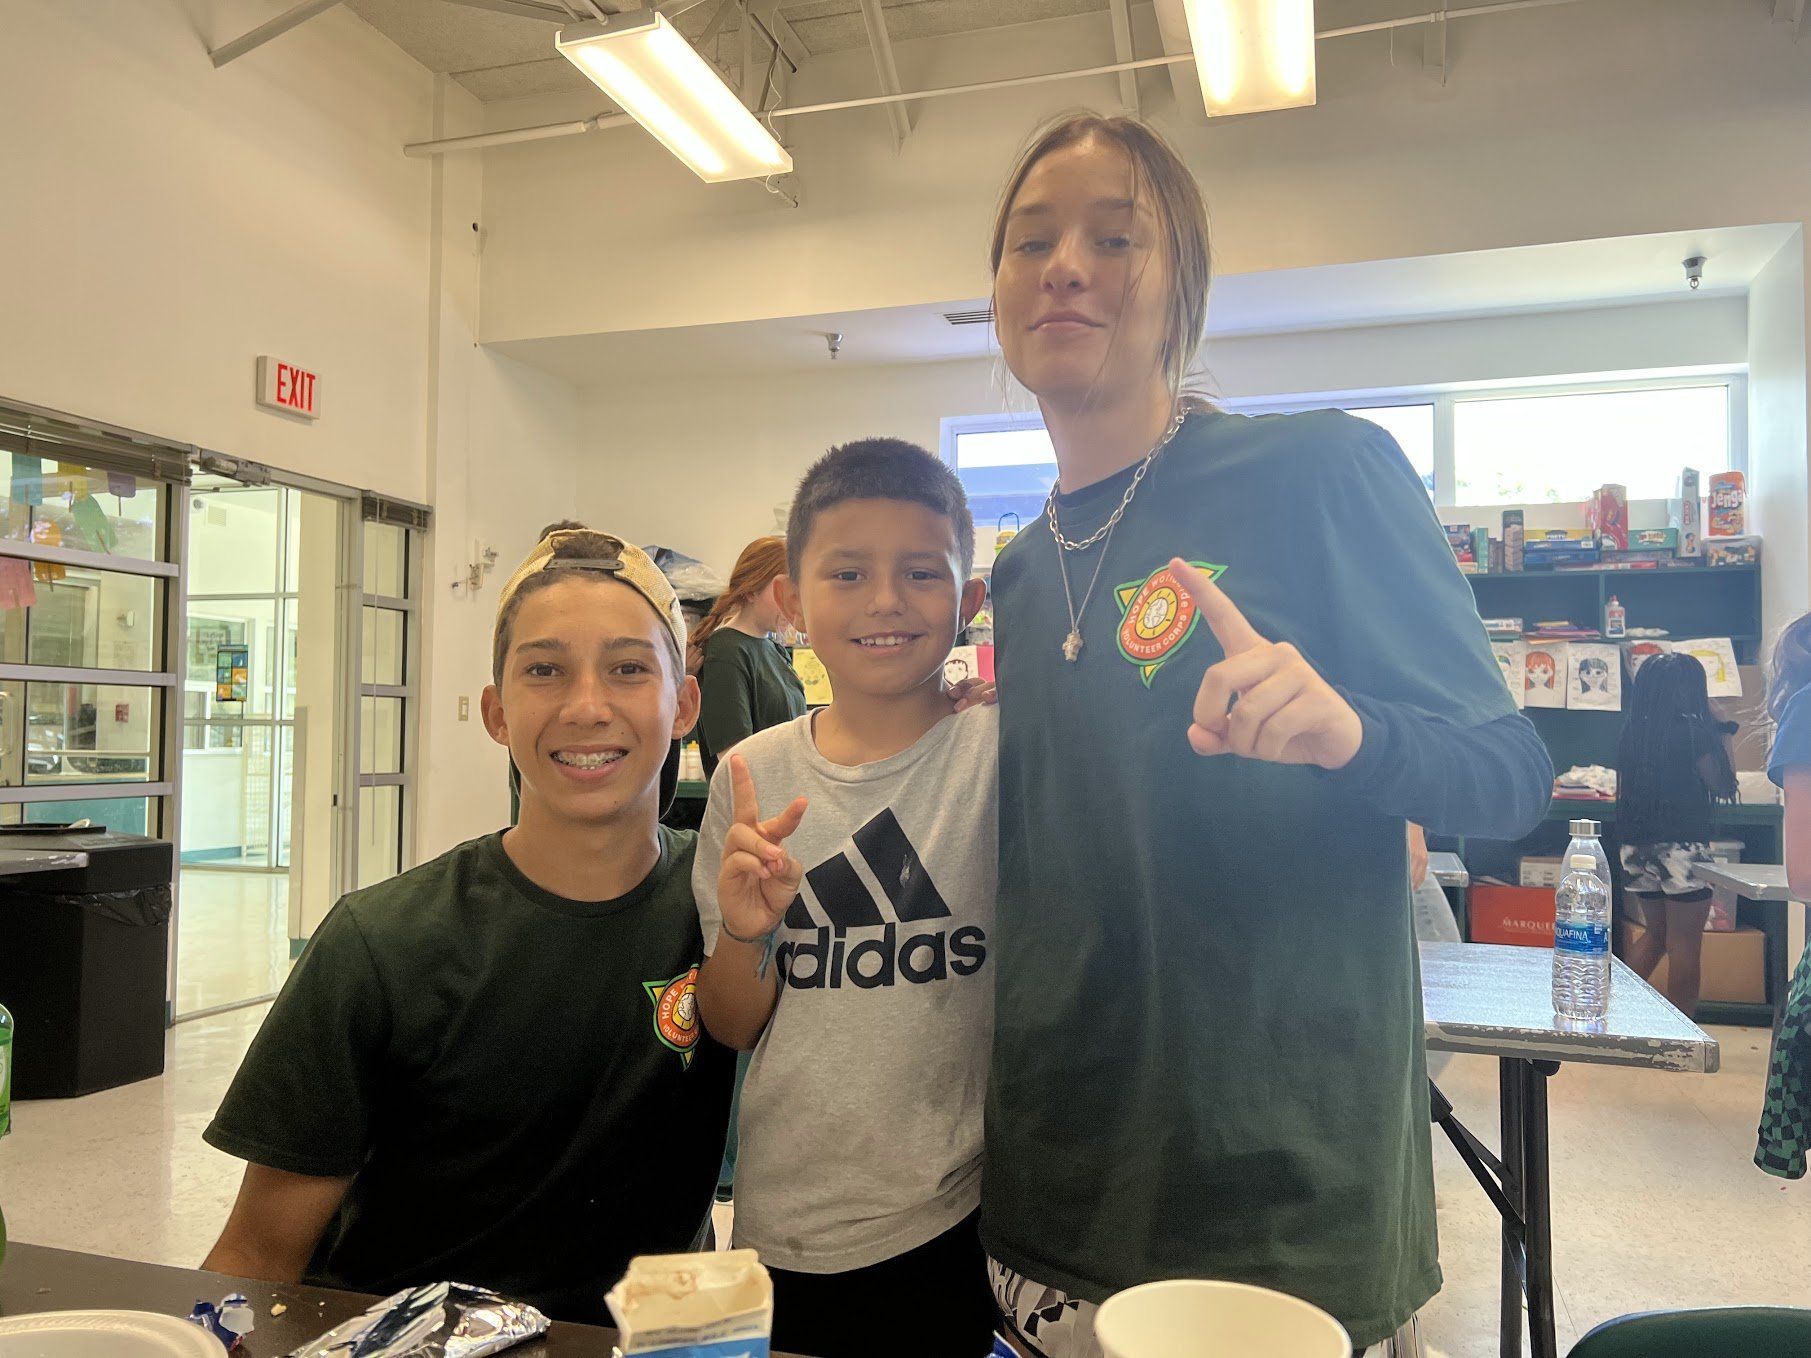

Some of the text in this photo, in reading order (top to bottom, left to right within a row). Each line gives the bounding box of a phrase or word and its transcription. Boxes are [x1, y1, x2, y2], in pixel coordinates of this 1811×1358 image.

[277, 363, 316, 412] EXIT
[1129, 587, 1150, 624] HOPE
[1122, 614, 1187, 653] VOLUNTEER CORPS
[1555, 927, 1588, 943] QUAFINA
[776, 922, 987, 989] adidas
[662, 988, 679, 1019] HOPE
